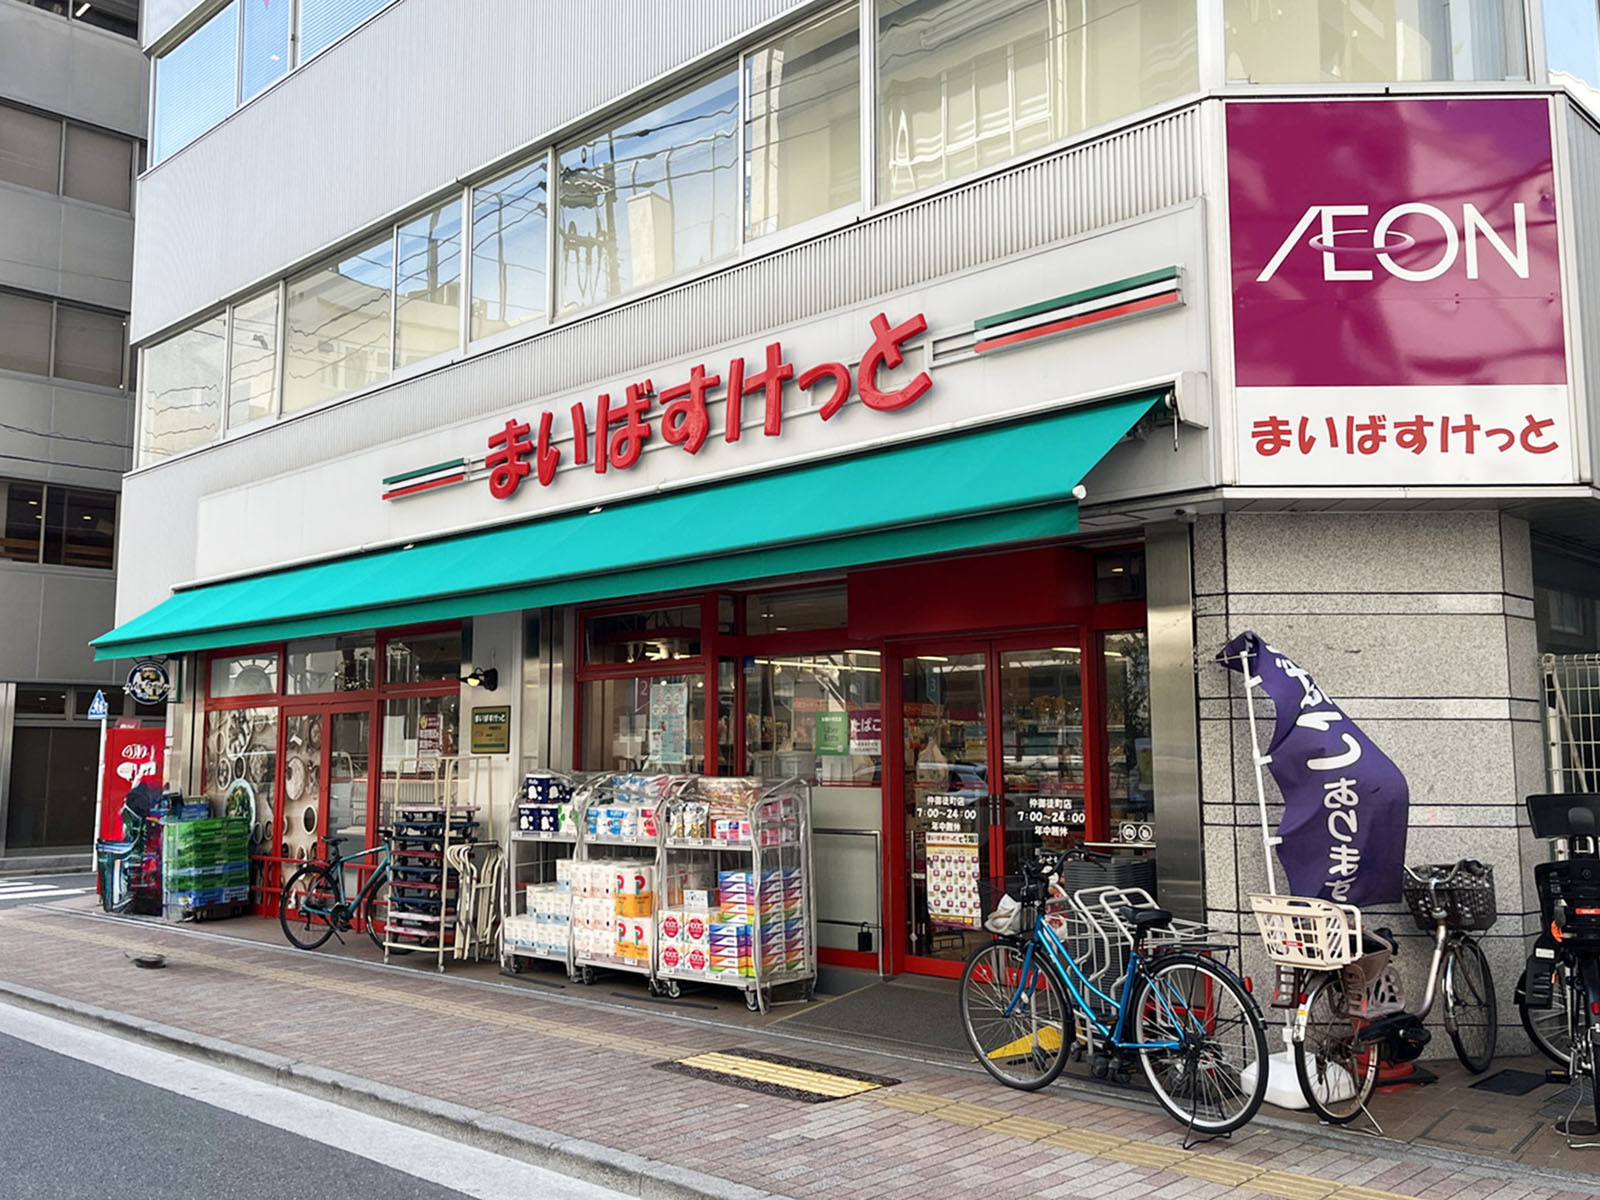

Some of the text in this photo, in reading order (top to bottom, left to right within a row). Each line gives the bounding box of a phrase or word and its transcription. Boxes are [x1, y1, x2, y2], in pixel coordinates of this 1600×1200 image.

[485, 312, 933, 500] まいばすけっと
[1251, 413, 1559, 457] まいばすけっと
[850, 717, 881, 733] たばこ
